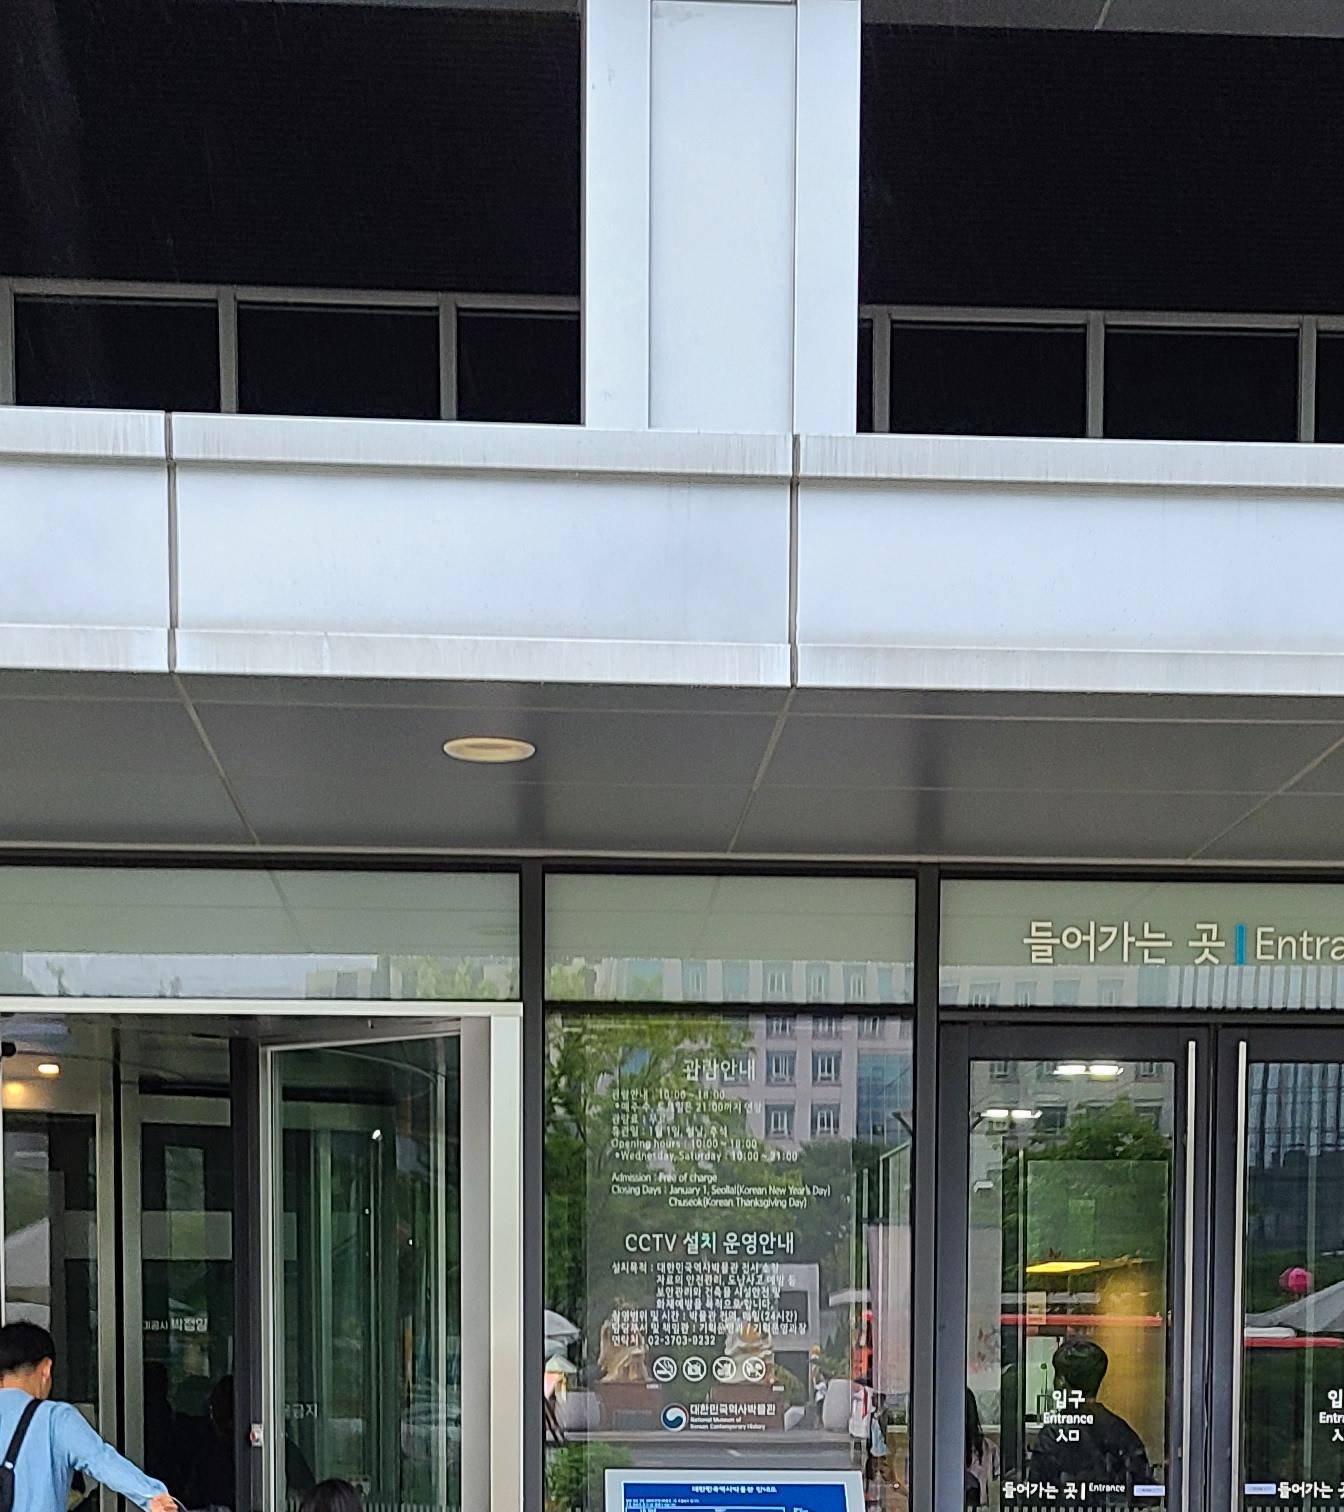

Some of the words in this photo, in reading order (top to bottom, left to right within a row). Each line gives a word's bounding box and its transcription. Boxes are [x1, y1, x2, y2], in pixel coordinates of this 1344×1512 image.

[1023, 921, 1173, 964] 들어가는
[1187, 922, 1226, 964] 곳
[683, 1058, 756, 1081] 관람안내
[611, 1138, 651, 1150] Opening
[654, 1138, 680, 1149] hours
[692, 1139, 718, 1149] 10:00
[678, 1151, 721, 1162] Saturday
[731, 1151, 759, 1161] 10:00
[611, 1172, 651, 1182] Admission
[679, 1172, 687, 1182] of
[689, 1172, 717, 1184] charge
[611, 1185, 640, 1196] Closing
[642, 1185, 661, 1196] Days
[670, 1185, 701, 1196] January
[769, 1184, 787, 1195] New
[736, 1197, 787, 1208] Thanksgiving
[624, 1233, 677, 1252] CCTV
[682, 1231, 716, 1254] 설치
[722, 1231, 795, 1254] 운영안내
[656, 1261, 738, 1274] 대한민국역사박물관
[1052, 1389, 1086, 1409] 입구
[689, 1403, 775, 1416] 대한민국역사박물관
[1043, 1411, 1094, 1425] Entrance
[1056, 1428, 1080, 1442] 入口
[1002, 1482, 1058, 1499] 들어가는
[1063, 1482, 1077, 1499] 곳
[1088, 1483, 1125, 1494] Entrance
[1277, 1482, 1333, 1499] 들어가는
